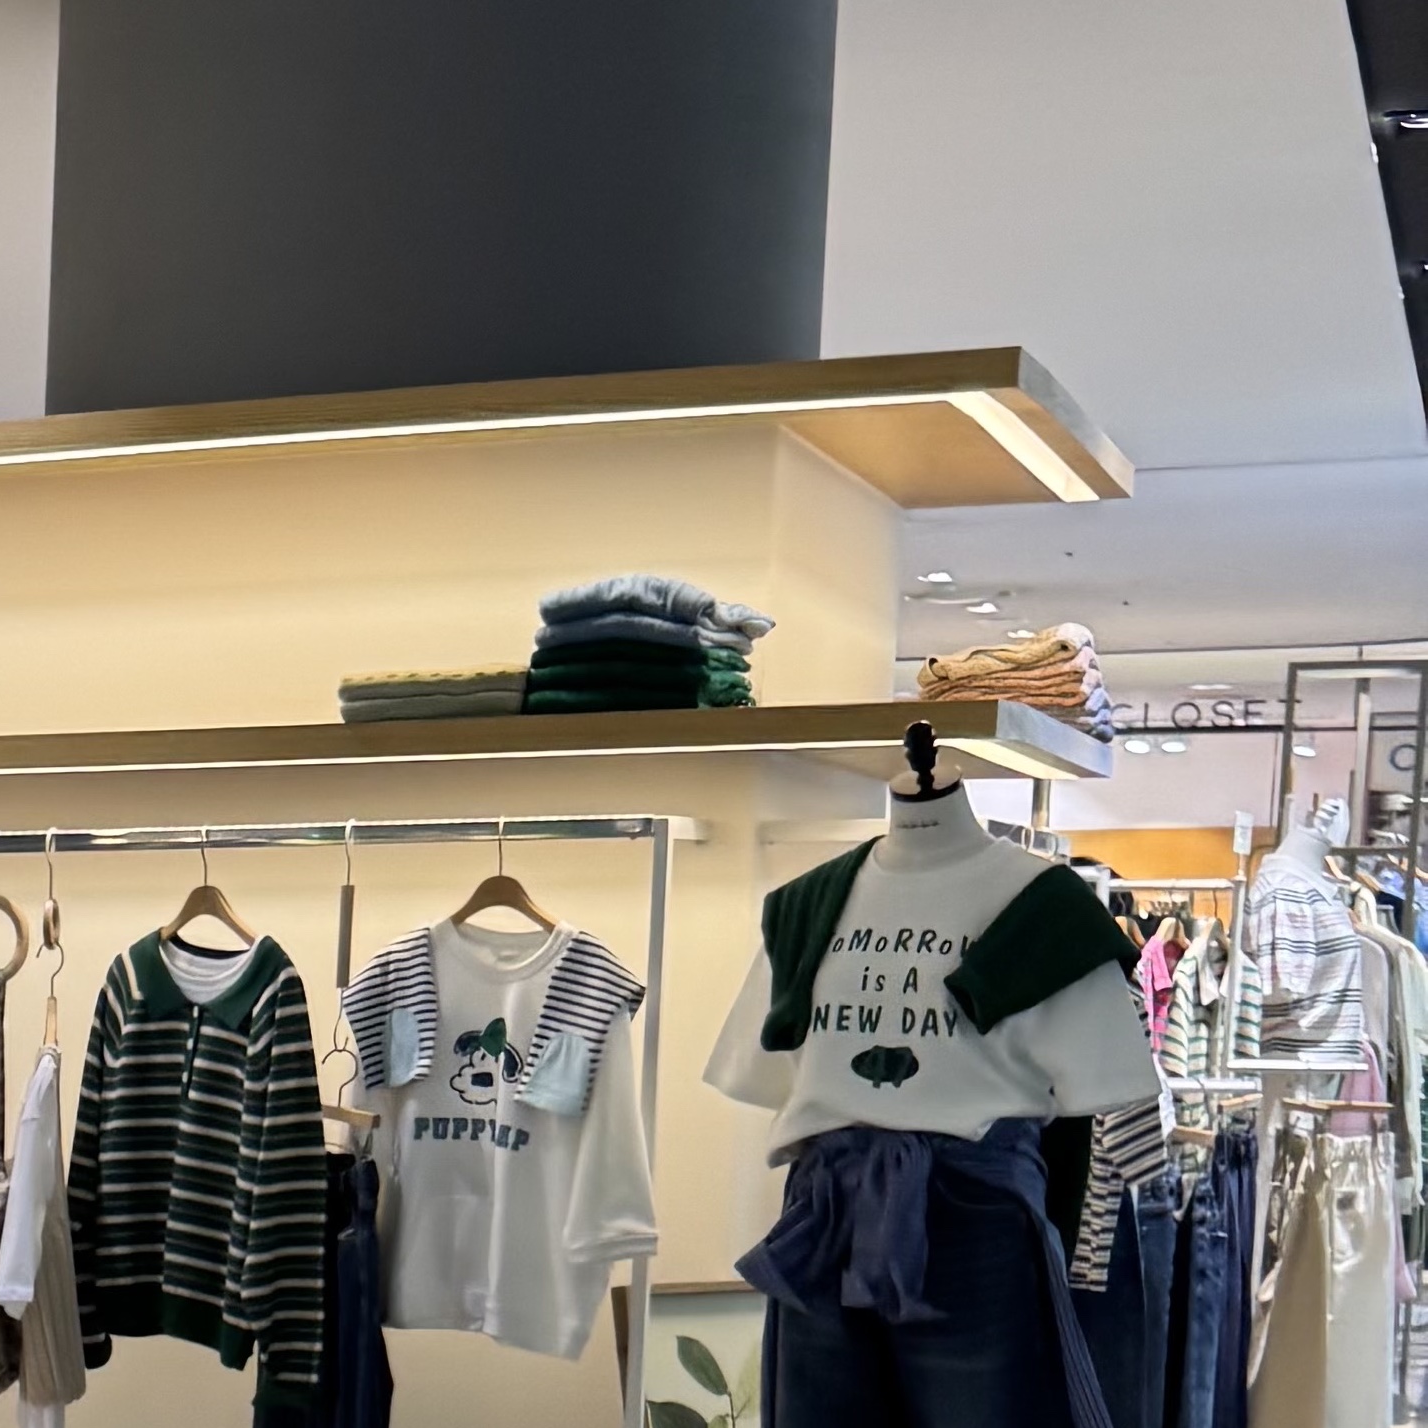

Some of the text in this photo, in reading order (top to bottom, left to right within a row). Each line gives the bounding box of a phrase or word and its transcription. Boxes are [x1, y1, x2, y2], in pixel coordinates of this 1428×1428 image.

[1110, 698, 1303, 729] CLOSE
[861, 966, 919, 994] is A
[812, 1003, 958, 1037] NEW DAY
